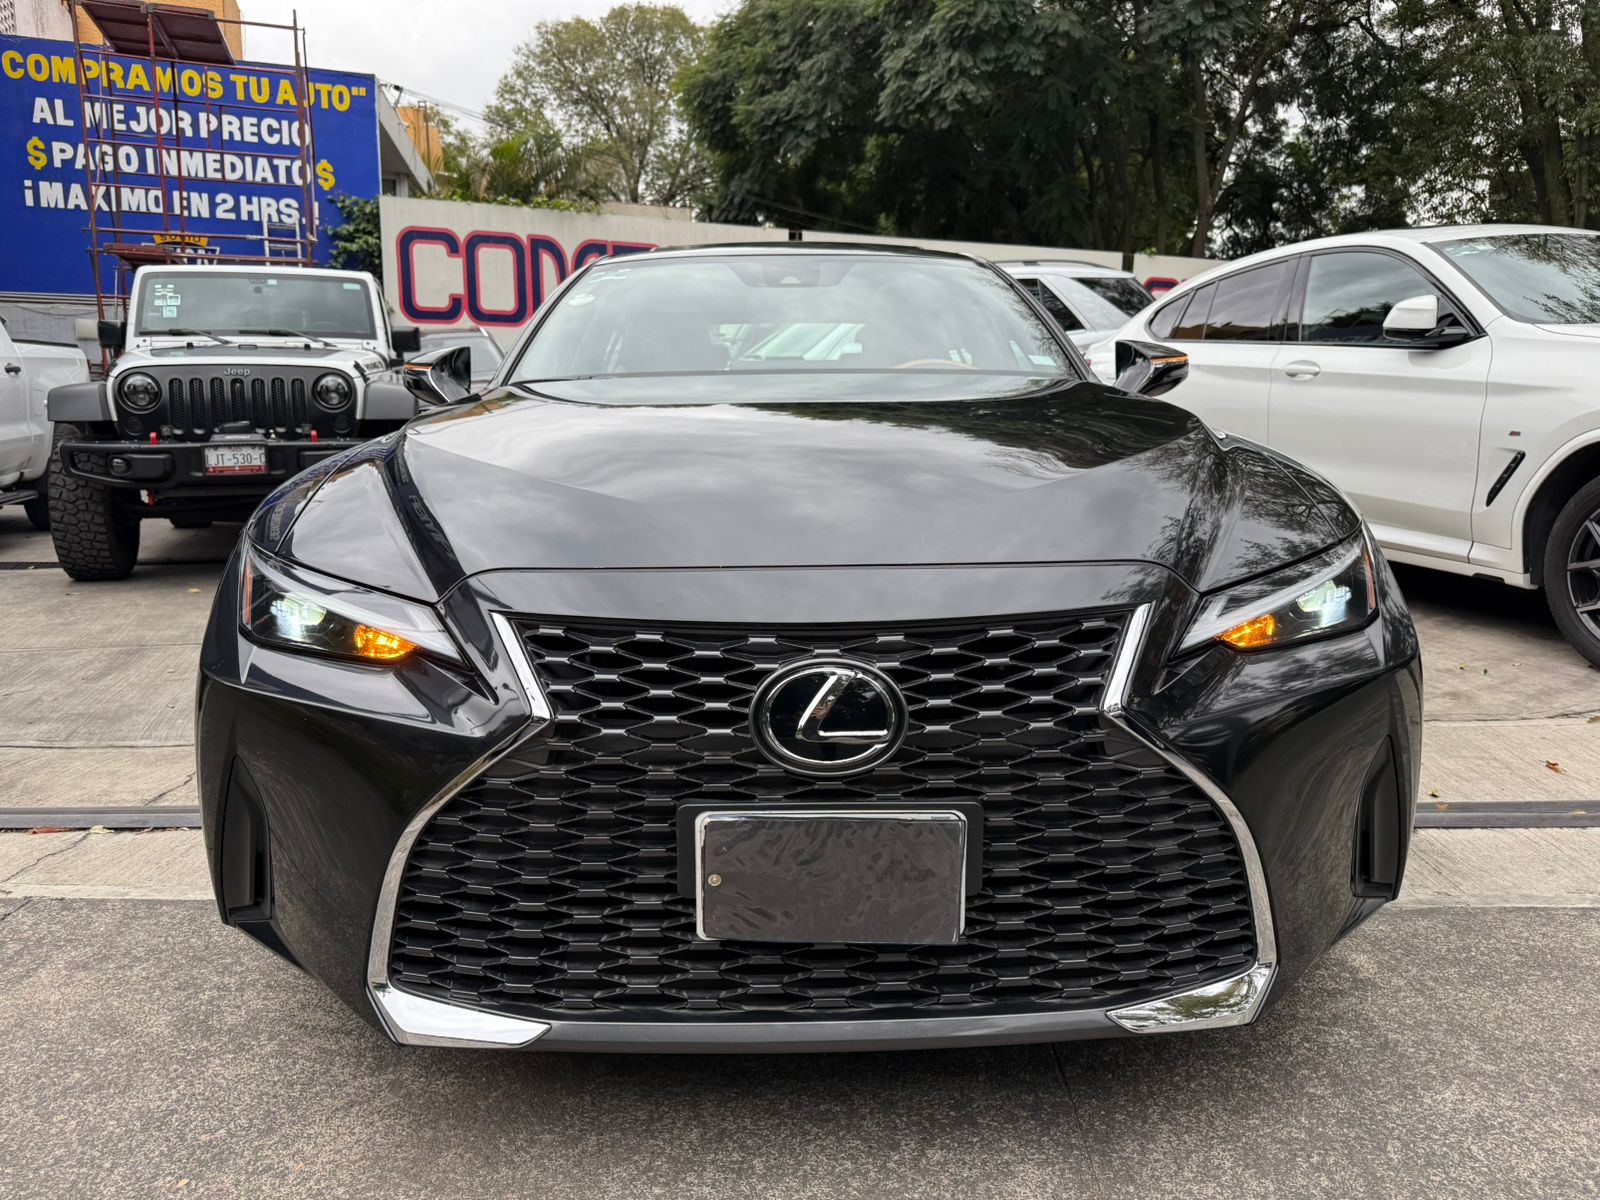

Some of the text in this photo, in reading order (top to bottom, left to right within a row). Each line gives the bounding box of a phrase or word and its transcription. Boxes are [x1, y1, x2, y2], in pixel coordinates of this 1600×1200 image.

[1, 50, 223, 98] COMPRAMOS
[230, 74, 270, 104] TU
[32, 97, 310, 148] AL MEJOR PRECIO
[172, 190, 210, 219] EN
[215, 192, 237, 220] 2
[223, 367, 251, 378] Jeep
